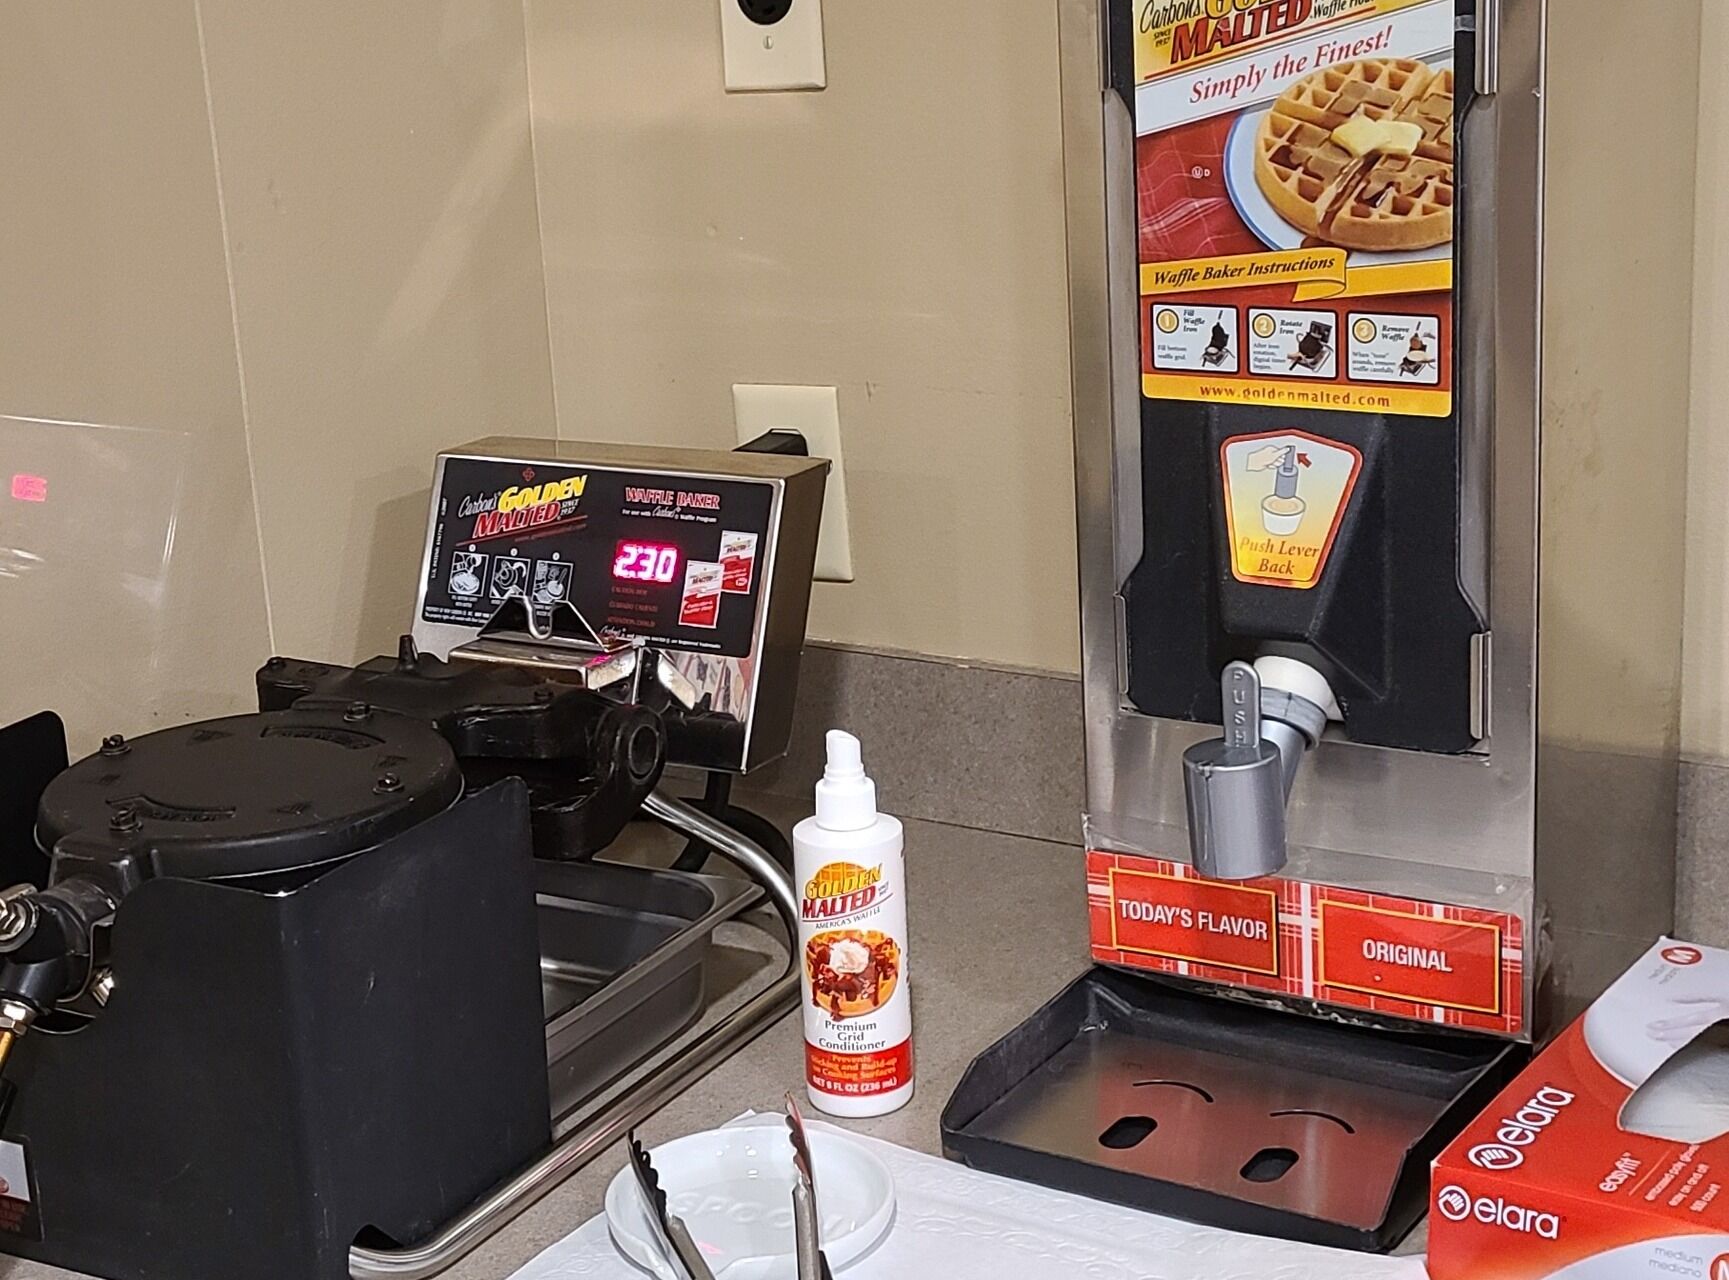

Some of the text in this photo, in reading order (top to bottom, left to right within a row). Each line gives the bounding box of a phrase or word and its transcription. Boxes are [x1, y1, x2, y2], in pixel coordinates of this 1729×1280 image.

[1189, 24, 1393, 104] Simply the Finest!
[1154, 256, 1335, 287] Waffle Baker Instructions
[1199, 385, 1390, 407] www.goldenmalted.com
[497, 474, 588, 513] GOLDEN
[625, 487, 721, 509] WAFFLE BAKER
[472, 501, 561, 539] MALTED
[1239, 536, 1320, 558] Push Lever
[1257, 558, 1295, 575] Back
[805, 863, 883, 899] GOLDEN
[802, 885, 876, 918] MALTED
[1118, 898, 1268, 941] TODAY'S FLAVOR
[1362, 938, 1453, 973] ORIGINAL
[1667, 949, 1697, 963] M
[825, 1020, 877, 1032] Premium
[837, 1032, 865, 1042] Grid
[819, 1037, 886, 1051] Conditioner
[1496, 1086, 1576, 1146] elara
[1599, 1154, 1642, 1193] easyfit
[1474, 1197, 1559, 1240] elara
[1649, 1258, 1702, 1280] mediano
[1654, 1246, 1703, 1267] medium
